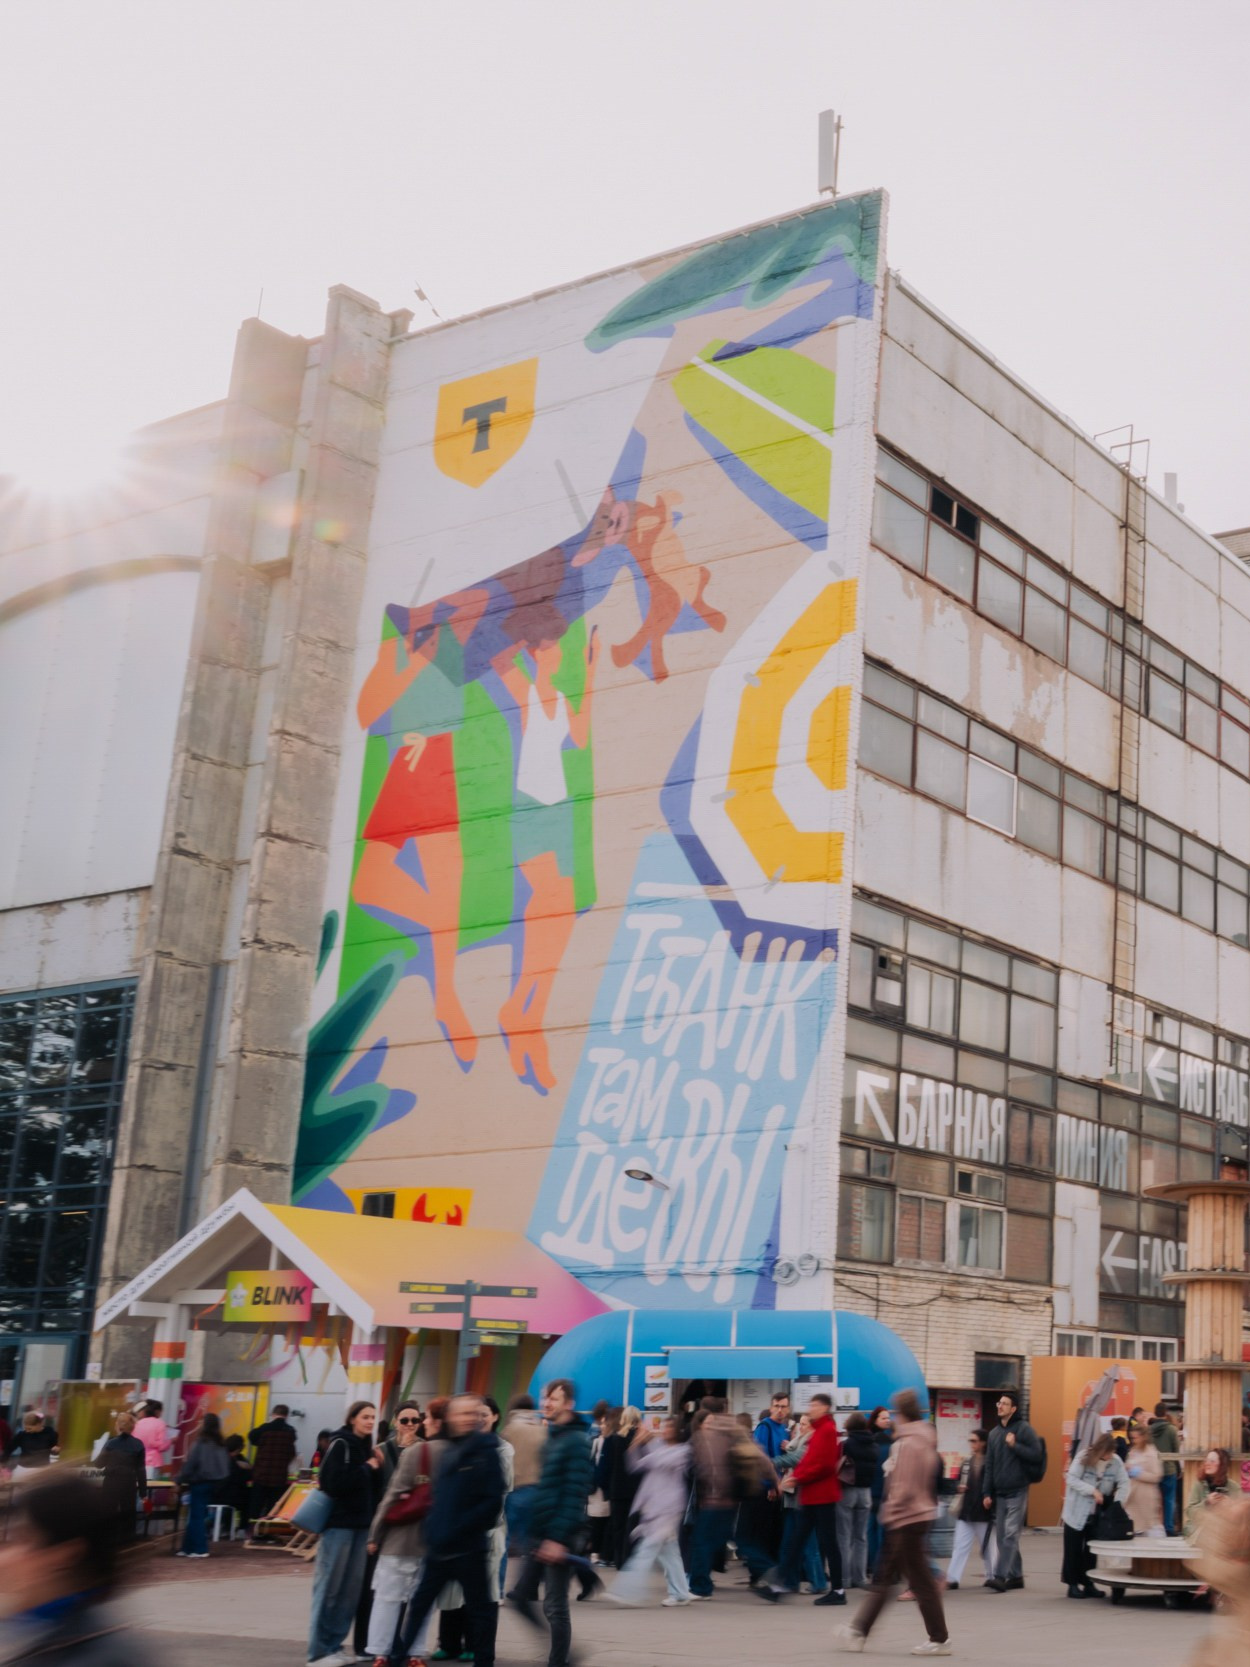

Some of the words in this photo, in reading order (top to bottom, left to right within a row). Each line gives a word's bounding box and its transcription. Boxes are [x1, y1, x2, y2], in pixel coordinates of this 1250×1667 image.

[1179, 1052, 1214, 1118] ИСТ
[898, 1072, 1006, 1166] БАРНАЯ
[1056, 1113, 1128, 1192] ЛИНИЯ
[251, 1286, 307, 1306] BLINK
[1138, 1235, 1188, 1301] EAST
